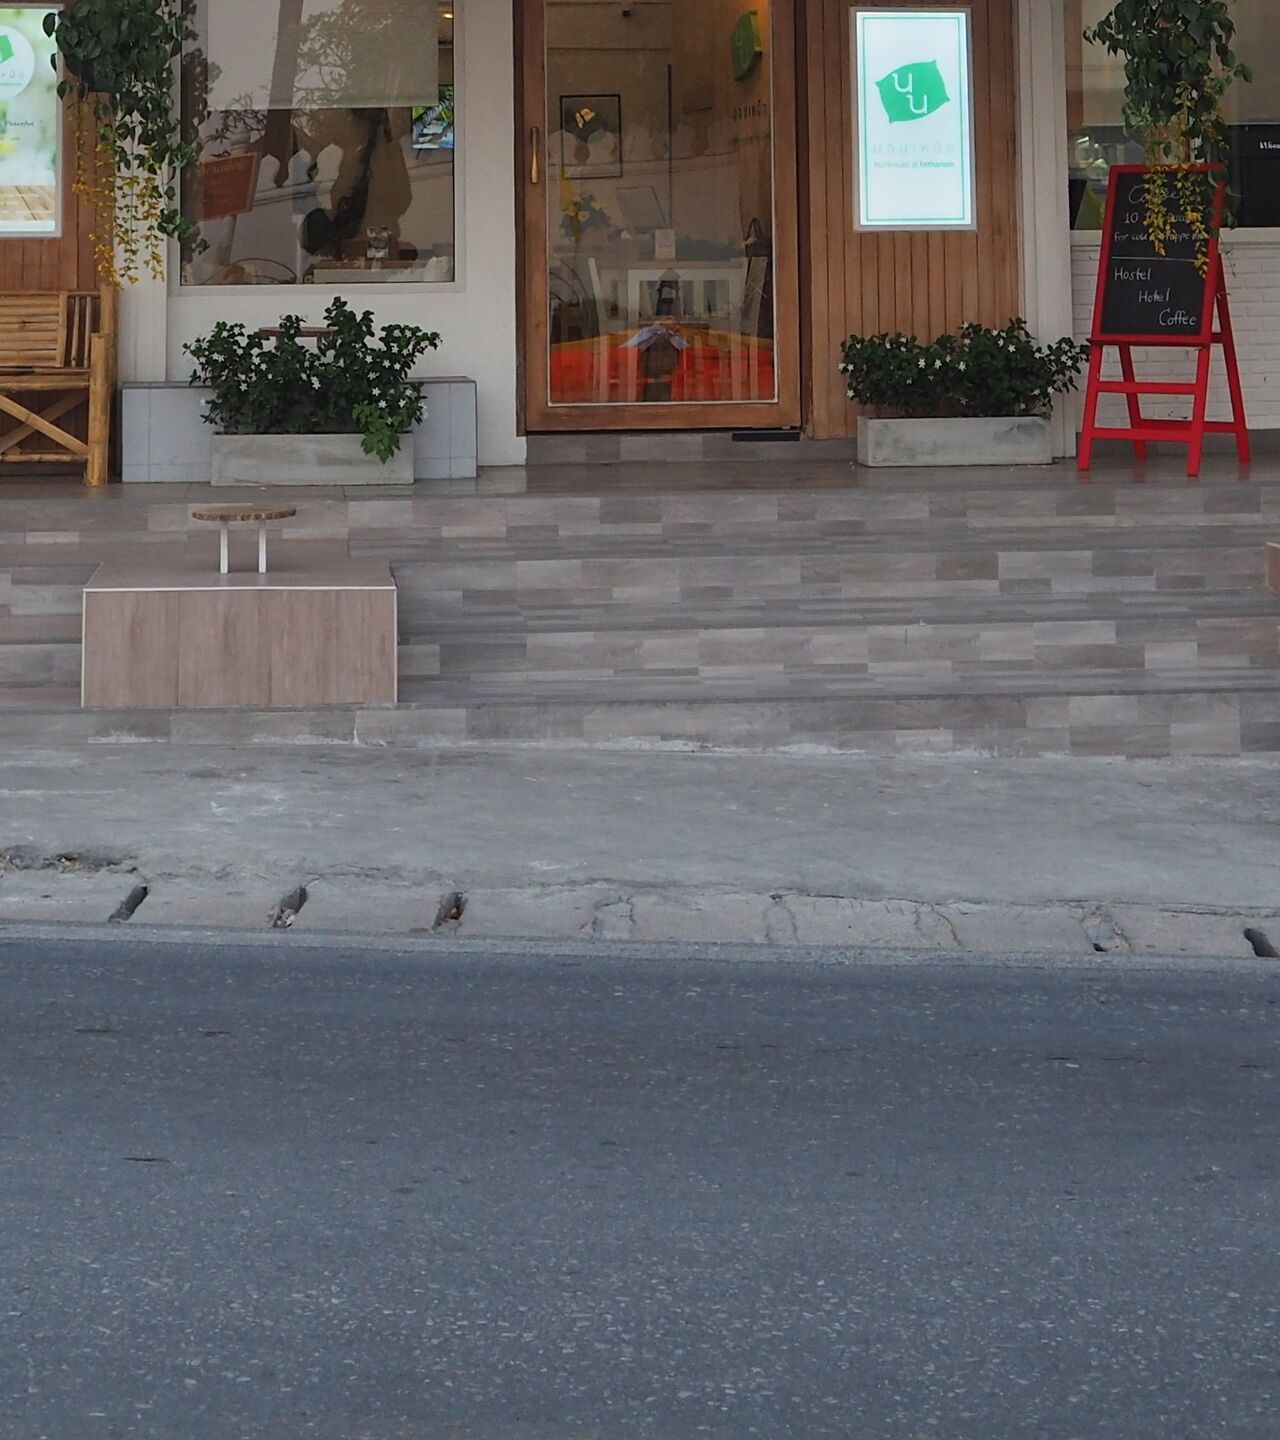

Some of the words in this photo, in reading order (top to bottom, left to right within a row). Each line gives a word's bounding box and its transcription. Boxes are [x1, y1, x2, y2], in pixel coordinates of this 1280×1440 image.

[1124, 212, 1139, 224] 10
[1114, 267, 1152, 281] Hostel
[1138, 288, 1171, 304] Hotel
[1158, 308, 1197, 326] Coffee
